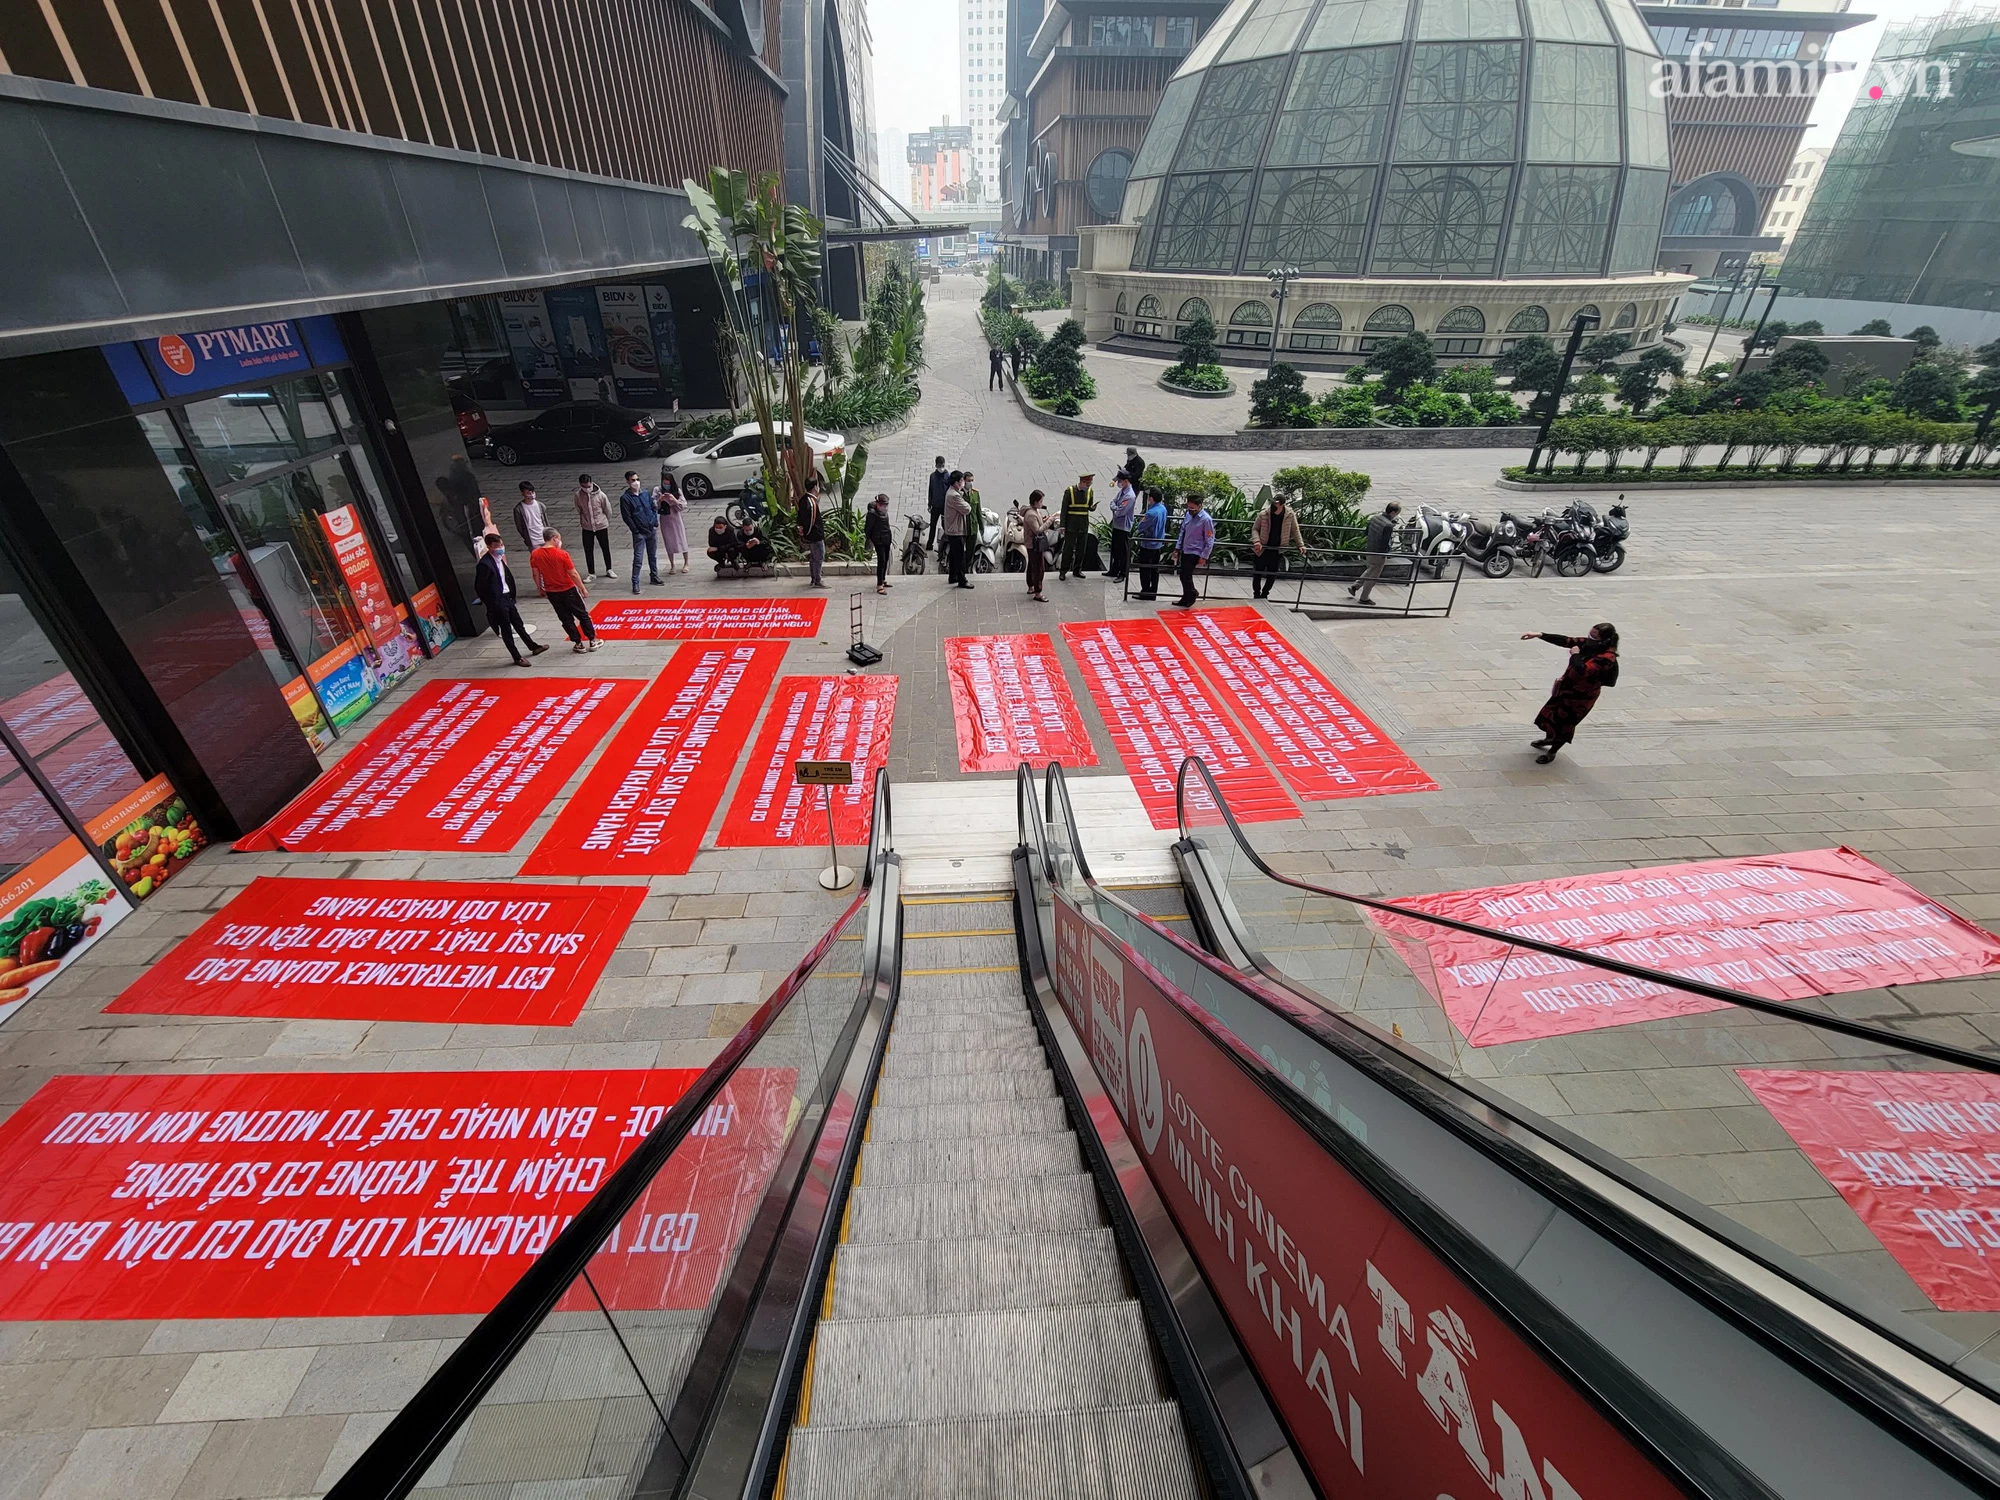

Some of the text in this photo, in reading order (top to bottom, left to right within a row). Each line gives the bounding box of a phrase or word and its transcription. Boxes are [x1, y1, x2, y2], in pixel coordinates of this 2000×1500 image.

[503, 293, 526, 302] BIDV
[602, 291, 625, 301] BIDV
[194, 322, 292, 360] PTMART
[688, 667, 716, 682] ĐẢO
[1021, 656, 1044, 673] HÀNG
[676, 685, 705, 702] TIỆN
[703, 663, 746, 712] VIETRACIMEX
[1027, 675, 1053, 698] KHÁCH
[648, 727, 681, 745] LỪA
[684, 716, 719, 747] QUẢNG
[1040, 715, 1065, 731] LỪA
[635, 749, 666, 766] DỐI
[669, 751, 701, 772] CÁO
[608, 771, 653, 809] KHÁCH
[656, 776, 688, 794] SAI
[102, 814, 120, 830] GIAO
[119, 801, 140, 819] HÀNG
[139, 789, 157, 806] MIỄN
[643, 799, 676, 816] SỰ
[459, 811, 501, 843] HINODE
[582, 813, 627, 849] HÀNG
[618, 820, 665, 858] THẬT,
[1552, 889, 1598, 909] CỦA
[1592, 884, 1639, 904] XÚC
[1675, 873, 1740, 897] QUYẾT
[305, 897, 550, 925] LỪA DỐI KHÁCH HÀNG
[1480, 897, 1526, 917] DÂN
[1523, 894, 1559, 912] CƯ
[214, 924, 585, 955] SAI SỰ THẬT, LỪA ĐẢO TIỆN ÍCH,
[1815, 914, 1878, 935] QUAN
[1617, 939, 1669, 965] CẦU
[1660, 935, 1710, 957] YÊU
[1868, 941, 1924, 963] DÂN
[1912, 937, 1956, 957] CƯ
[186, 959, 554, 990] CĐT VIETRACIMEX QUẢNG CÁO
[1754, 955, 1810, 978] CITY
[1092, 958, 1122, 1035] 55K
[1522, 987, 1578, 1014] CỨU
[1570, 981, 1623, 1006] KÊU
[1117, 1058, 1123, 1079] 2
[1121, 1090, 1127, 1111] 6
[44, 1112, 148, 1143] NGƯU
[138, 1112, 214, 1142] KIM
[201, 1111, 327, 1142] MƯƠNG
[322, 1110, 371, 1147] TỪ
[359, 1109, 441, 1150] CHẾ
[440, 1103, 529, 1139] NHẠC
[530, 1107, 597, 1146] BẢN
[1873, 1102, 1976, 1140] HÀNG
[113, 1154, 605, 1210] CHẬM TRỄ, KHÔNG CÓ SỔ HỒNG,
[1837, 1148, 1930, 1194] ÍCH,
[180, 1220, 244, 1259] CƯ
[330, 1218, 406, 1265] LỪA
[629, 1213, 698, 1252] CĐT
[1167, 1078, 1224, 1179] LOTTE
[1230, 1164, 1362, 1376] CINEMA
[1912, 1209, 2000, 1256] CÁO
[17, 1222, 106, 1269] BÀN
[106, 1219, 194, 1267] DÂN,
[245, 1219, 330, 1269] ĐẢO
[1167, 1135, 1236, 1263] MINH
[1245, 1243, 1365, 1476] KHAI
